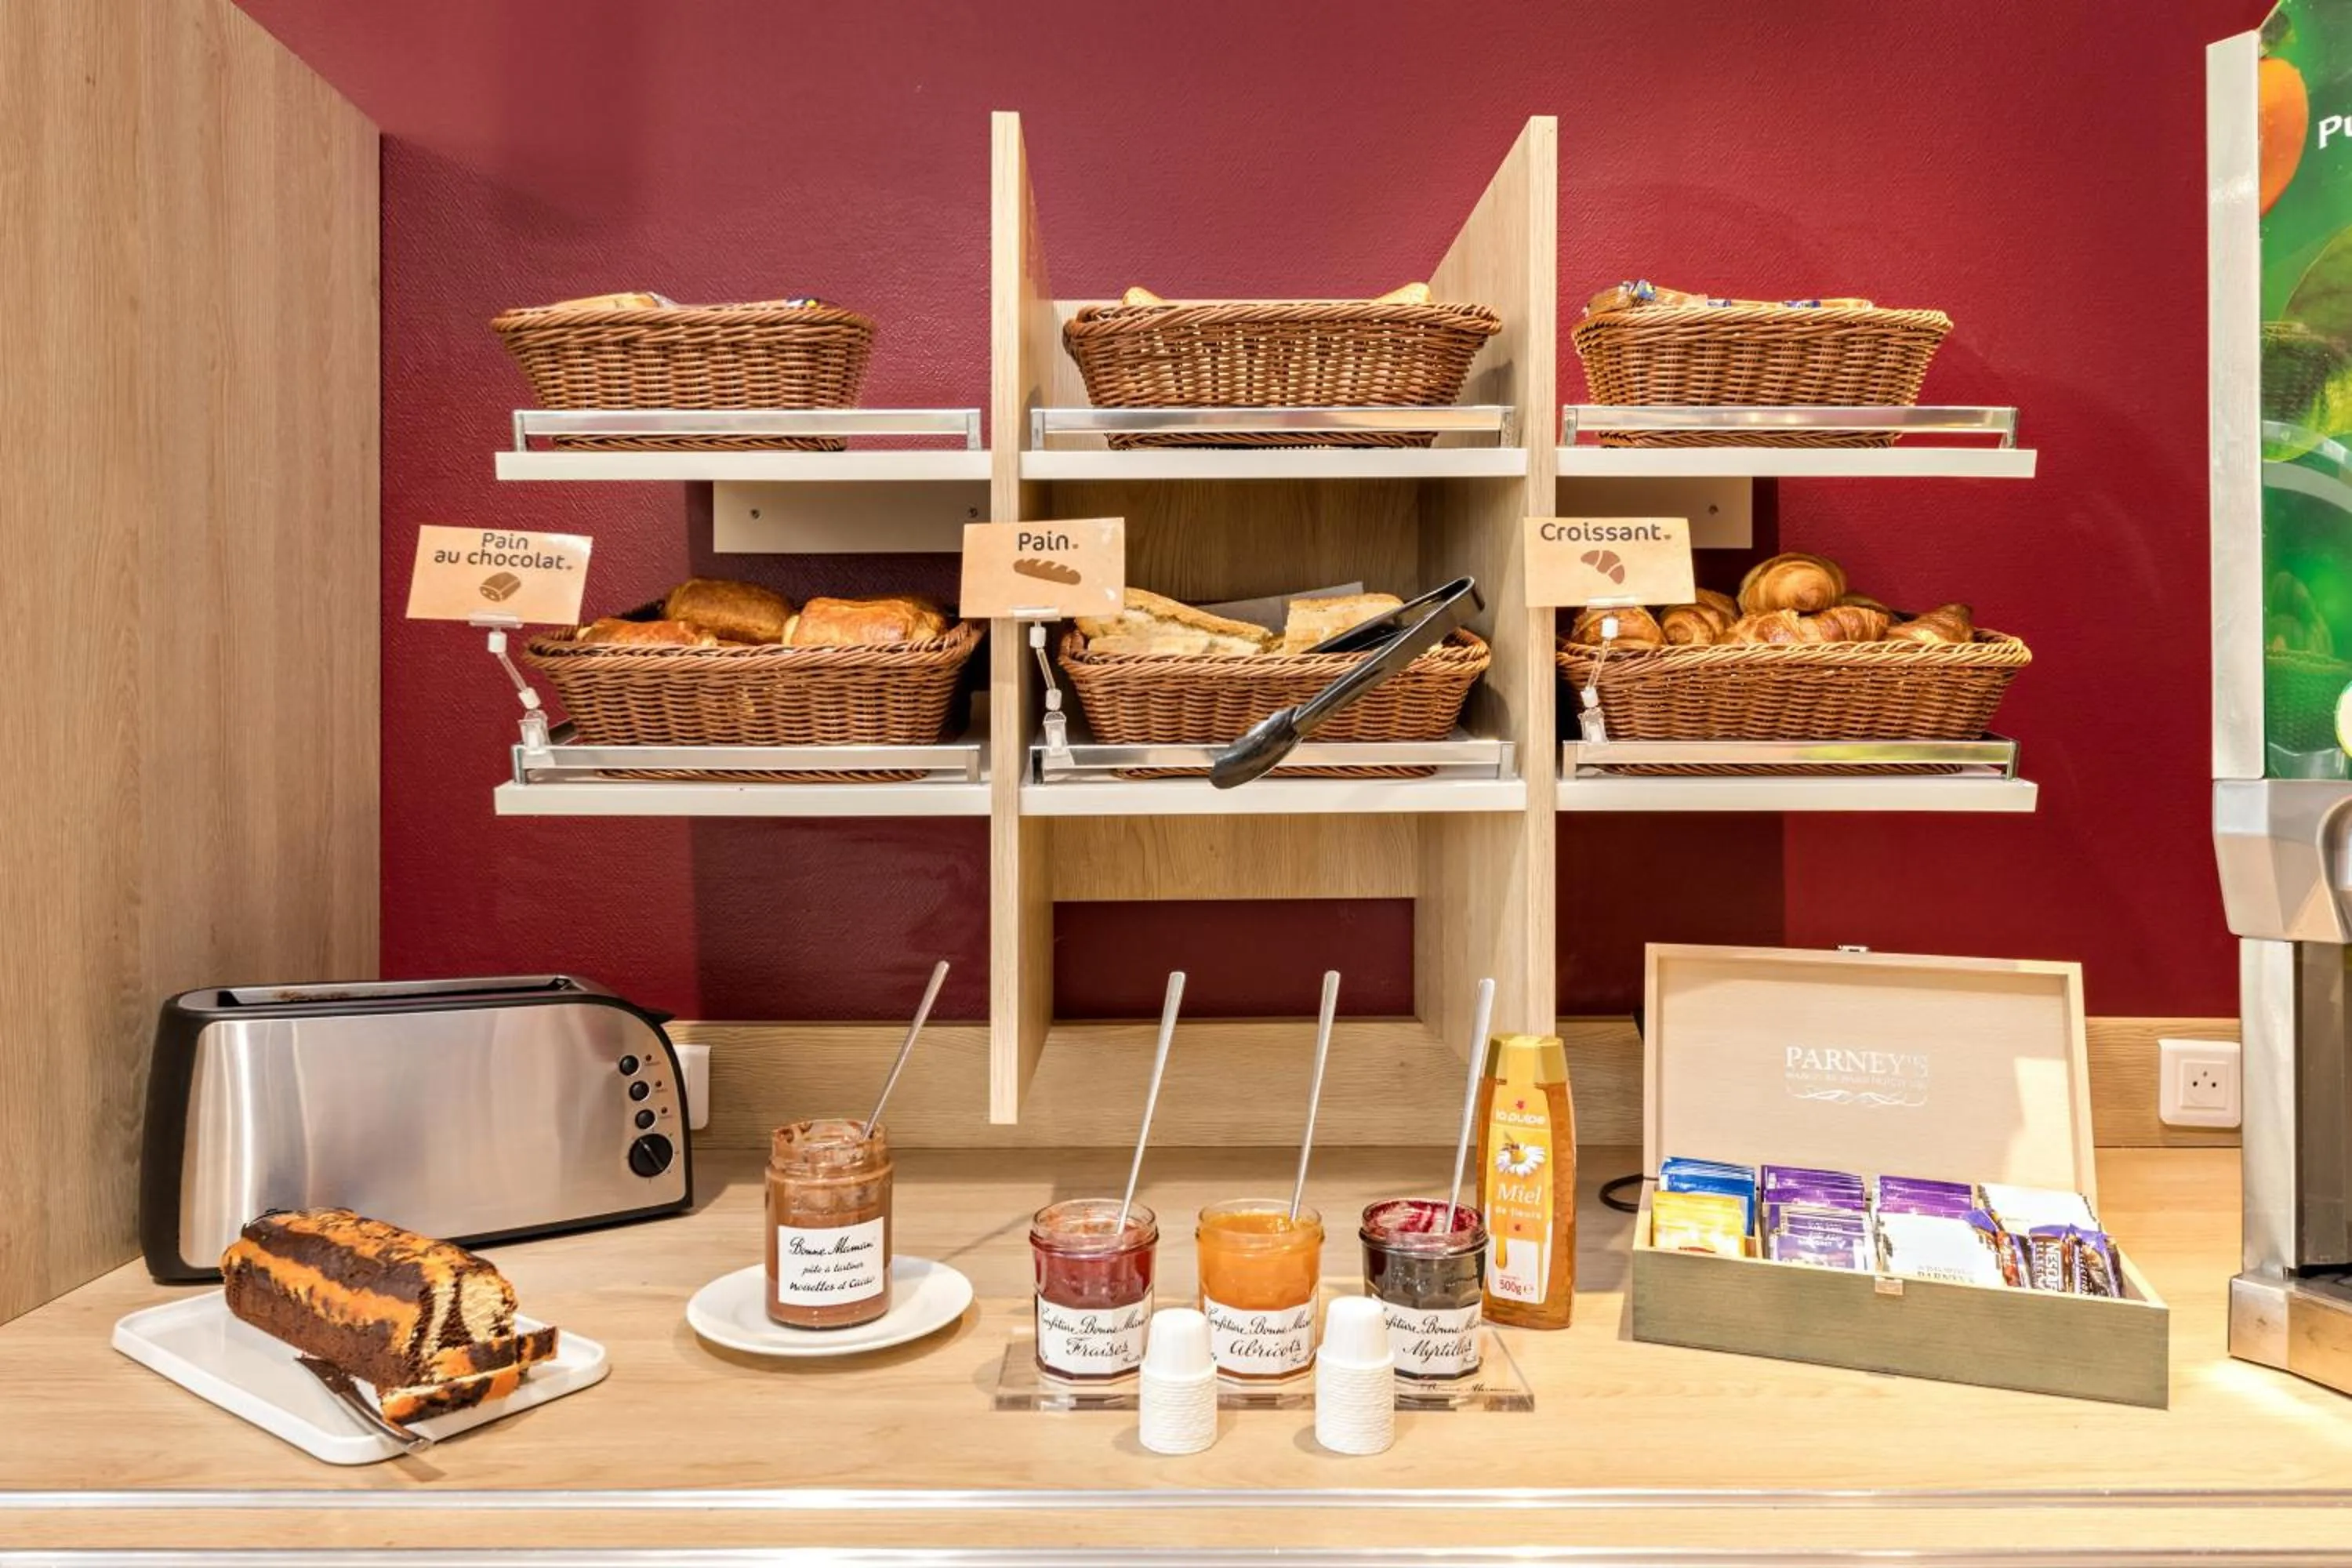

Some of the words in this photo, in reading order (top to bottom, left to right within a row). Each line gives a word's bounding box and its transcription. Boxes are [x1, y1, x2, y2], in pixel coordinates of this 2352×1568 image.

[481, 532, 529, 550] Pain
[1018, 531, 1079, 550] Pain.
[1541, 522, 1671, 541] Croissant.
[434, 550, 460, 564] au
[467, 549, 574, 570] chocolat.
[1497, 1182, 1542, 1205] Miel
[2045, 1241, 2060, 1290] NESCAF
[1066, 1337, 1128, 1357] Fraises
[1229, 1338, 1301, 1358] Abricots
